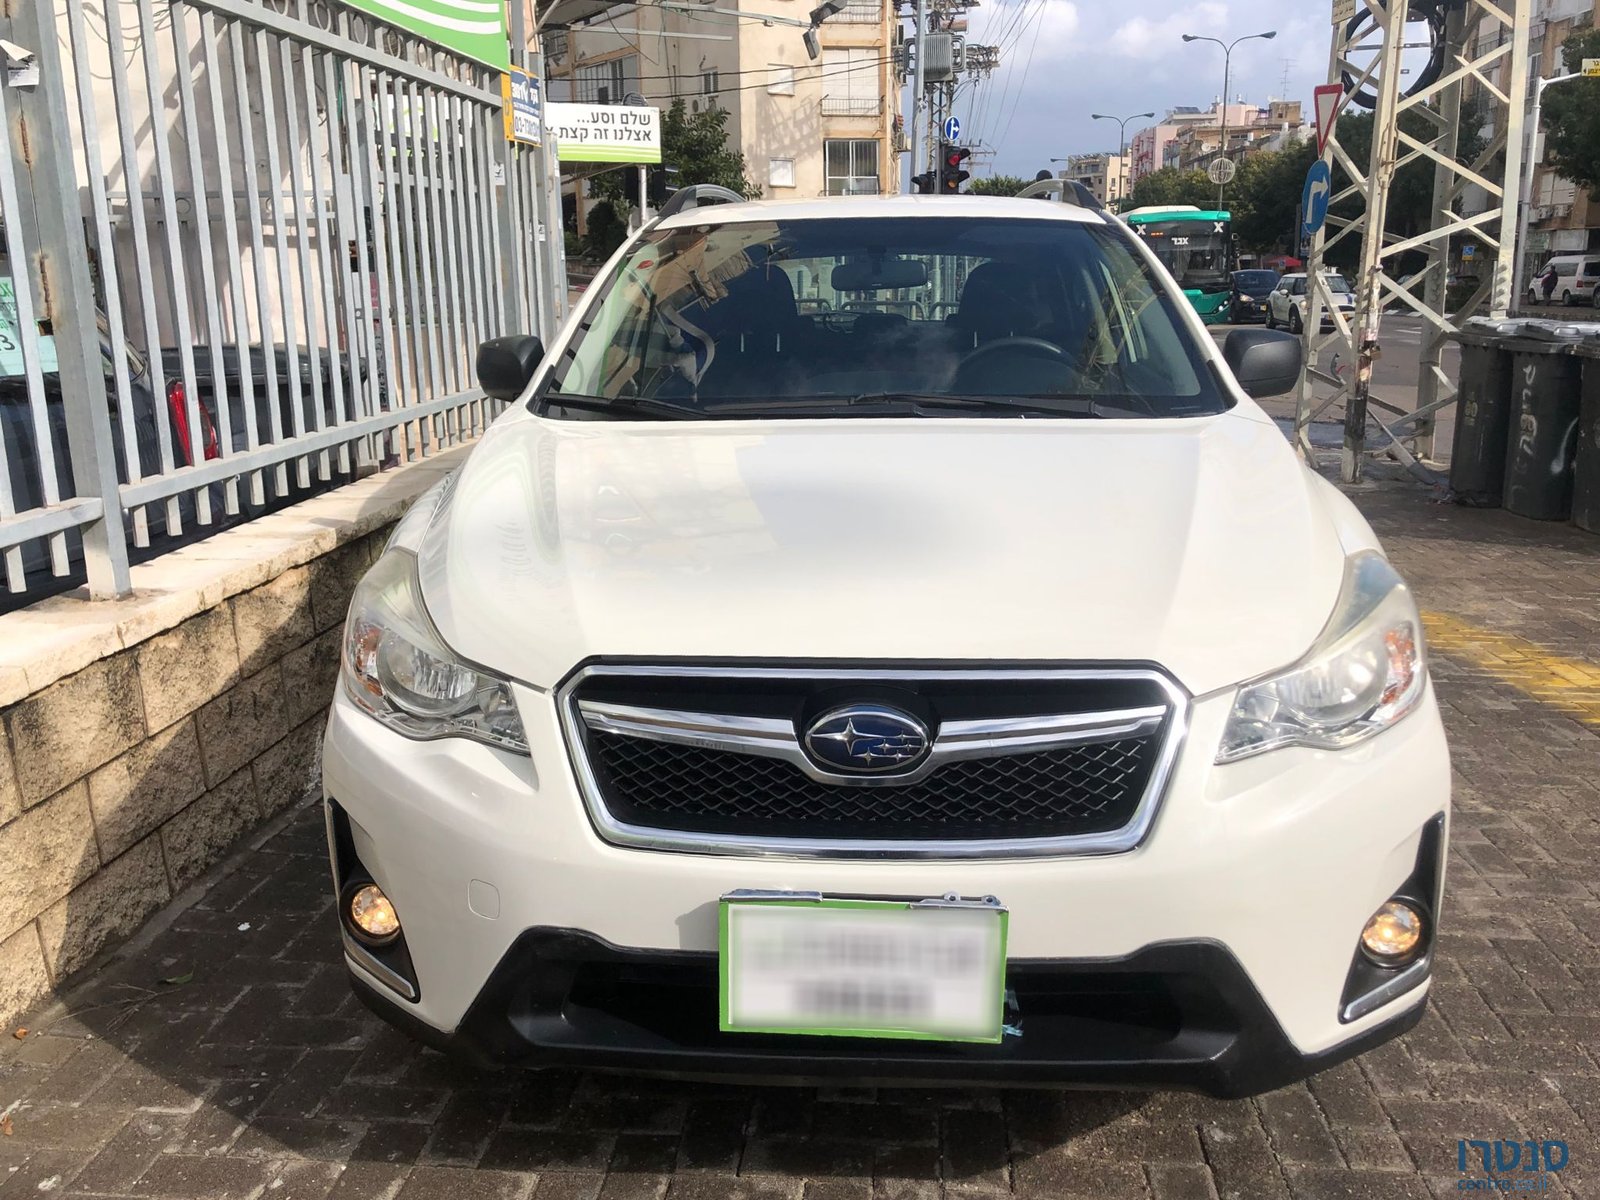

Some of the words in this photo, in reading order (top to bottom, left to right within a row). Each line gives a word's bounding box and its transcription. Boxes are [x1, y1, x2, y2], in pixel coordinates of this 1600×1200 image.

[577, 112, 615, 124] וסע...
[620, 111, 651, 126] שלם
[558, 126, 589, 143] קצת
[594, 128, 609, 140] זה
[613, 126, 652, 142] אצלנו
